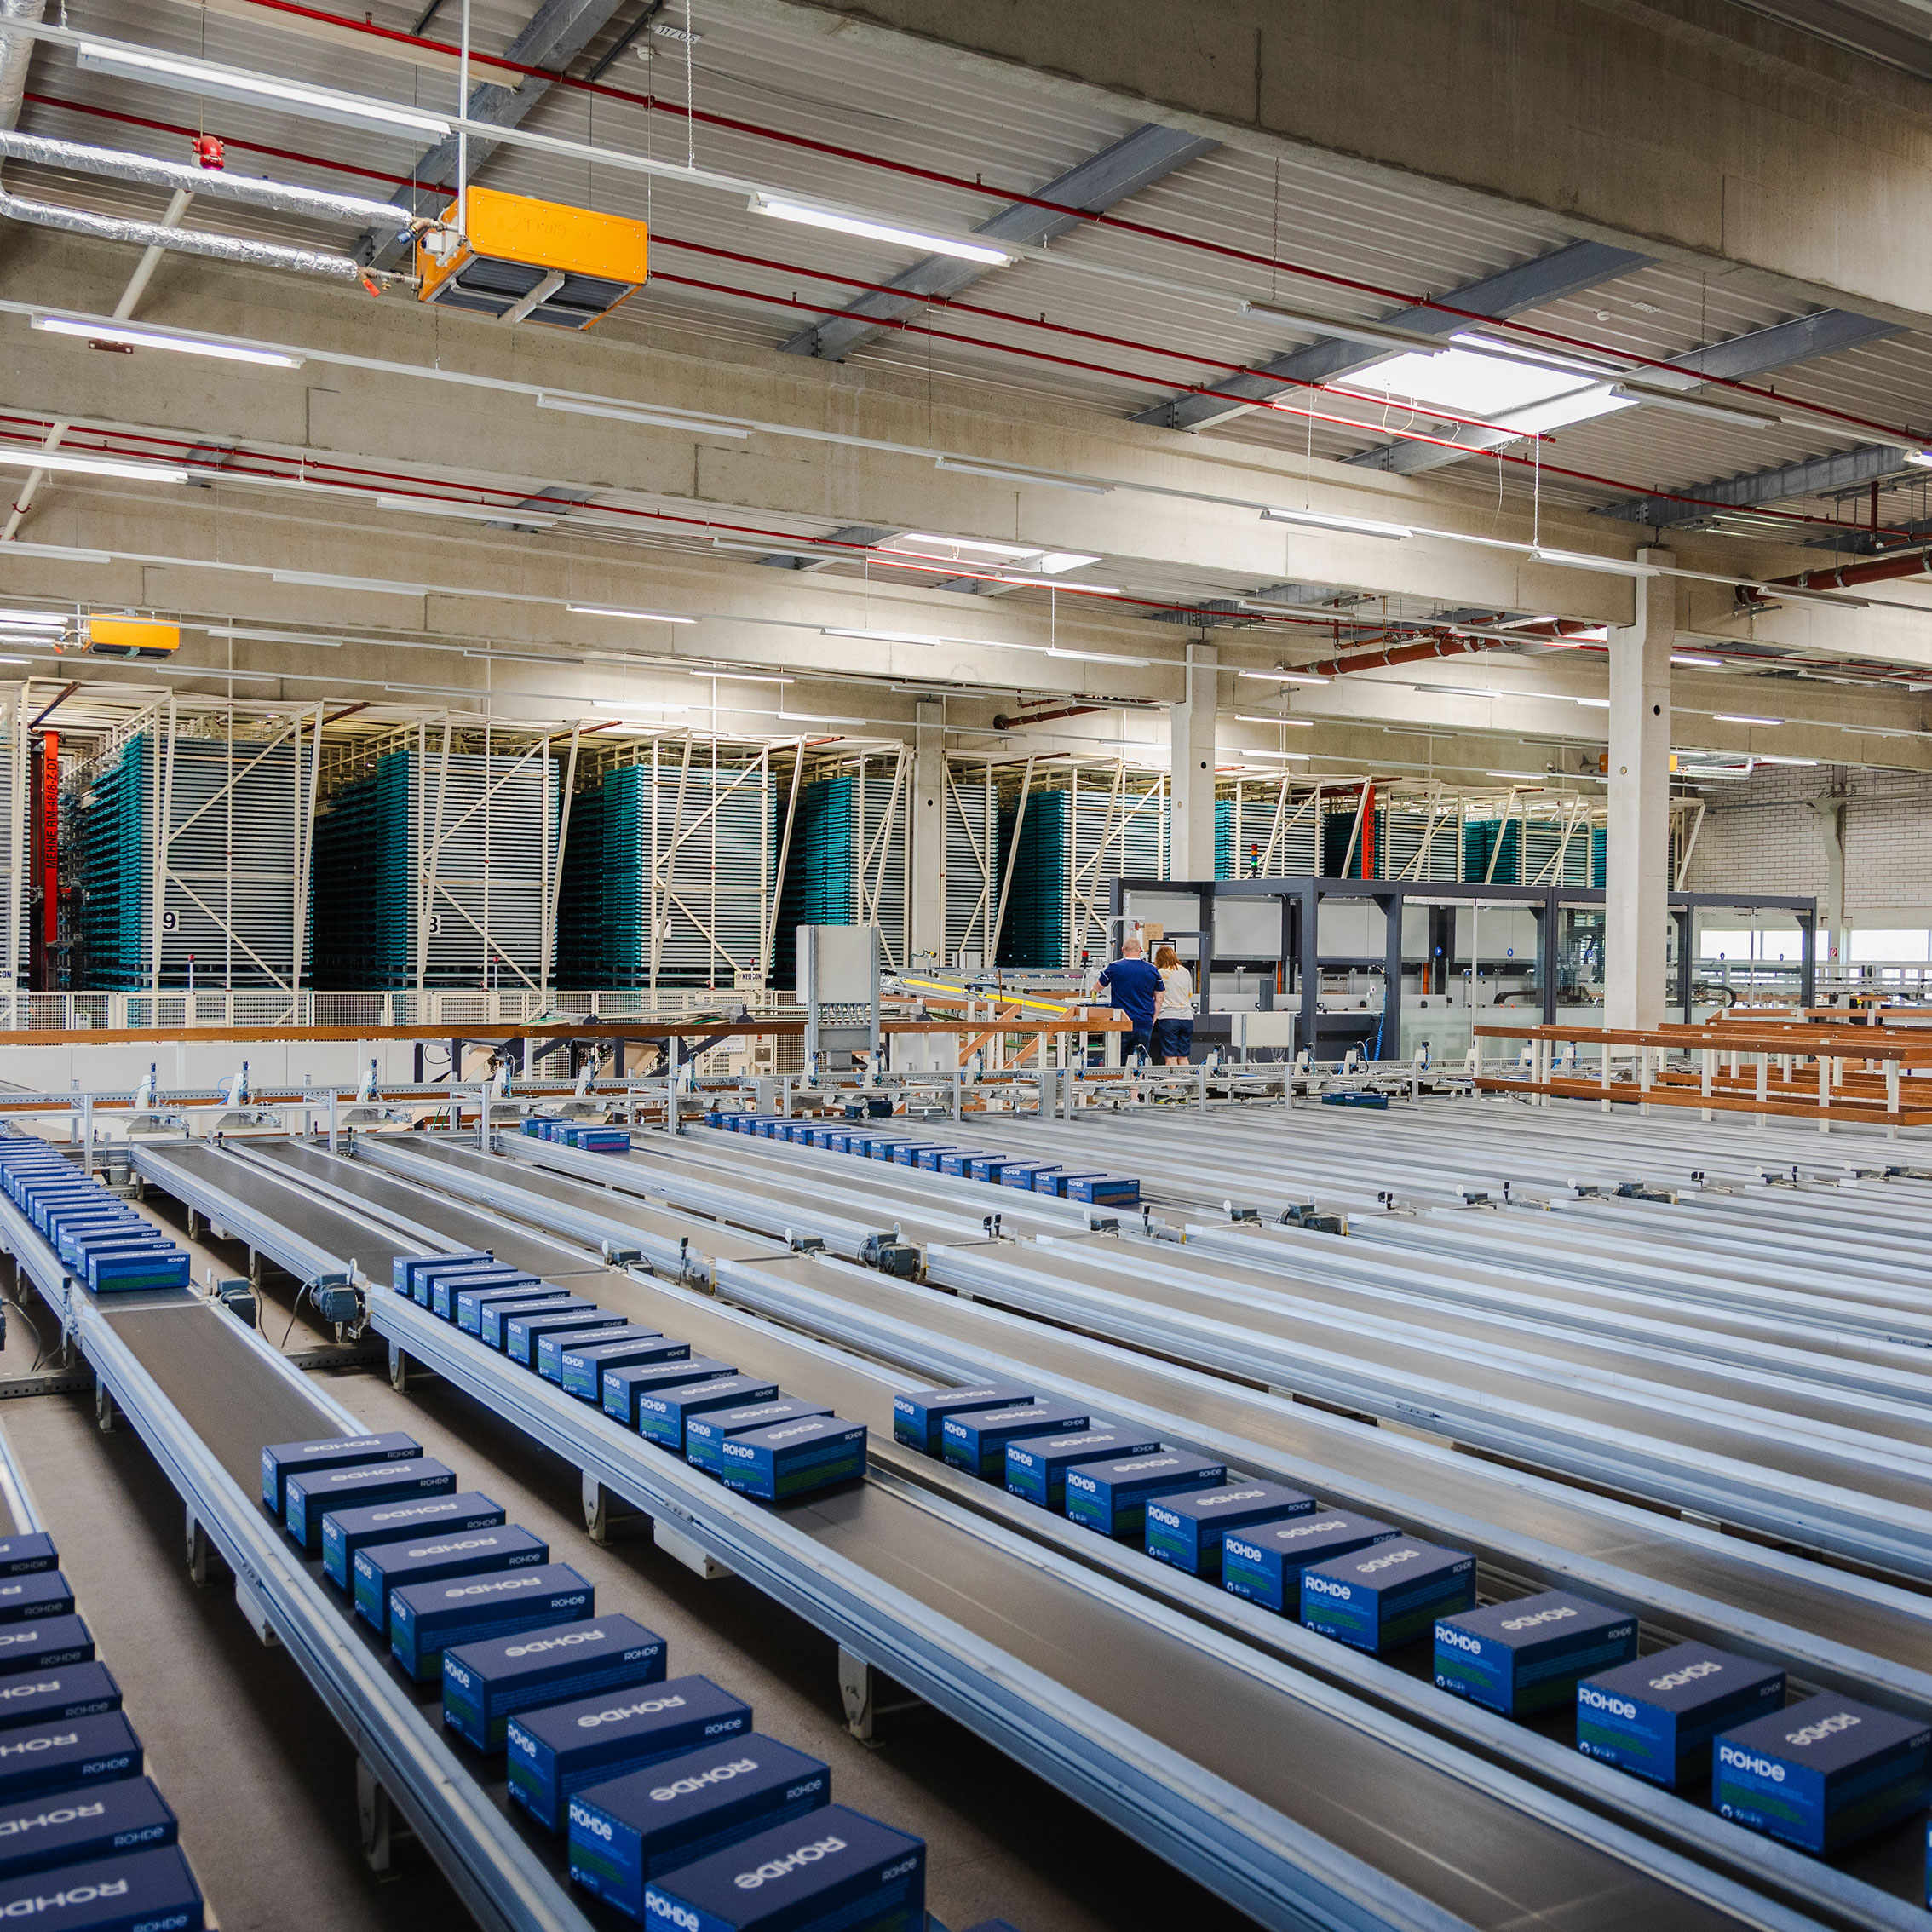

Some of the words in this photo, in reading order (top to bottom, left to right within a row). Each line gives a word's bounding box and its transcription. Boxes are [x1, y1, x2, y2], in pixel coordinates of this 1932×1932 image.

[659, 26, 698, 43] 11/05
[45, 756, 58, 827] RM-48/8-Z-DT
[46, 830, 57, 869] MEHNE
[163, 912, 175, 929] 9
